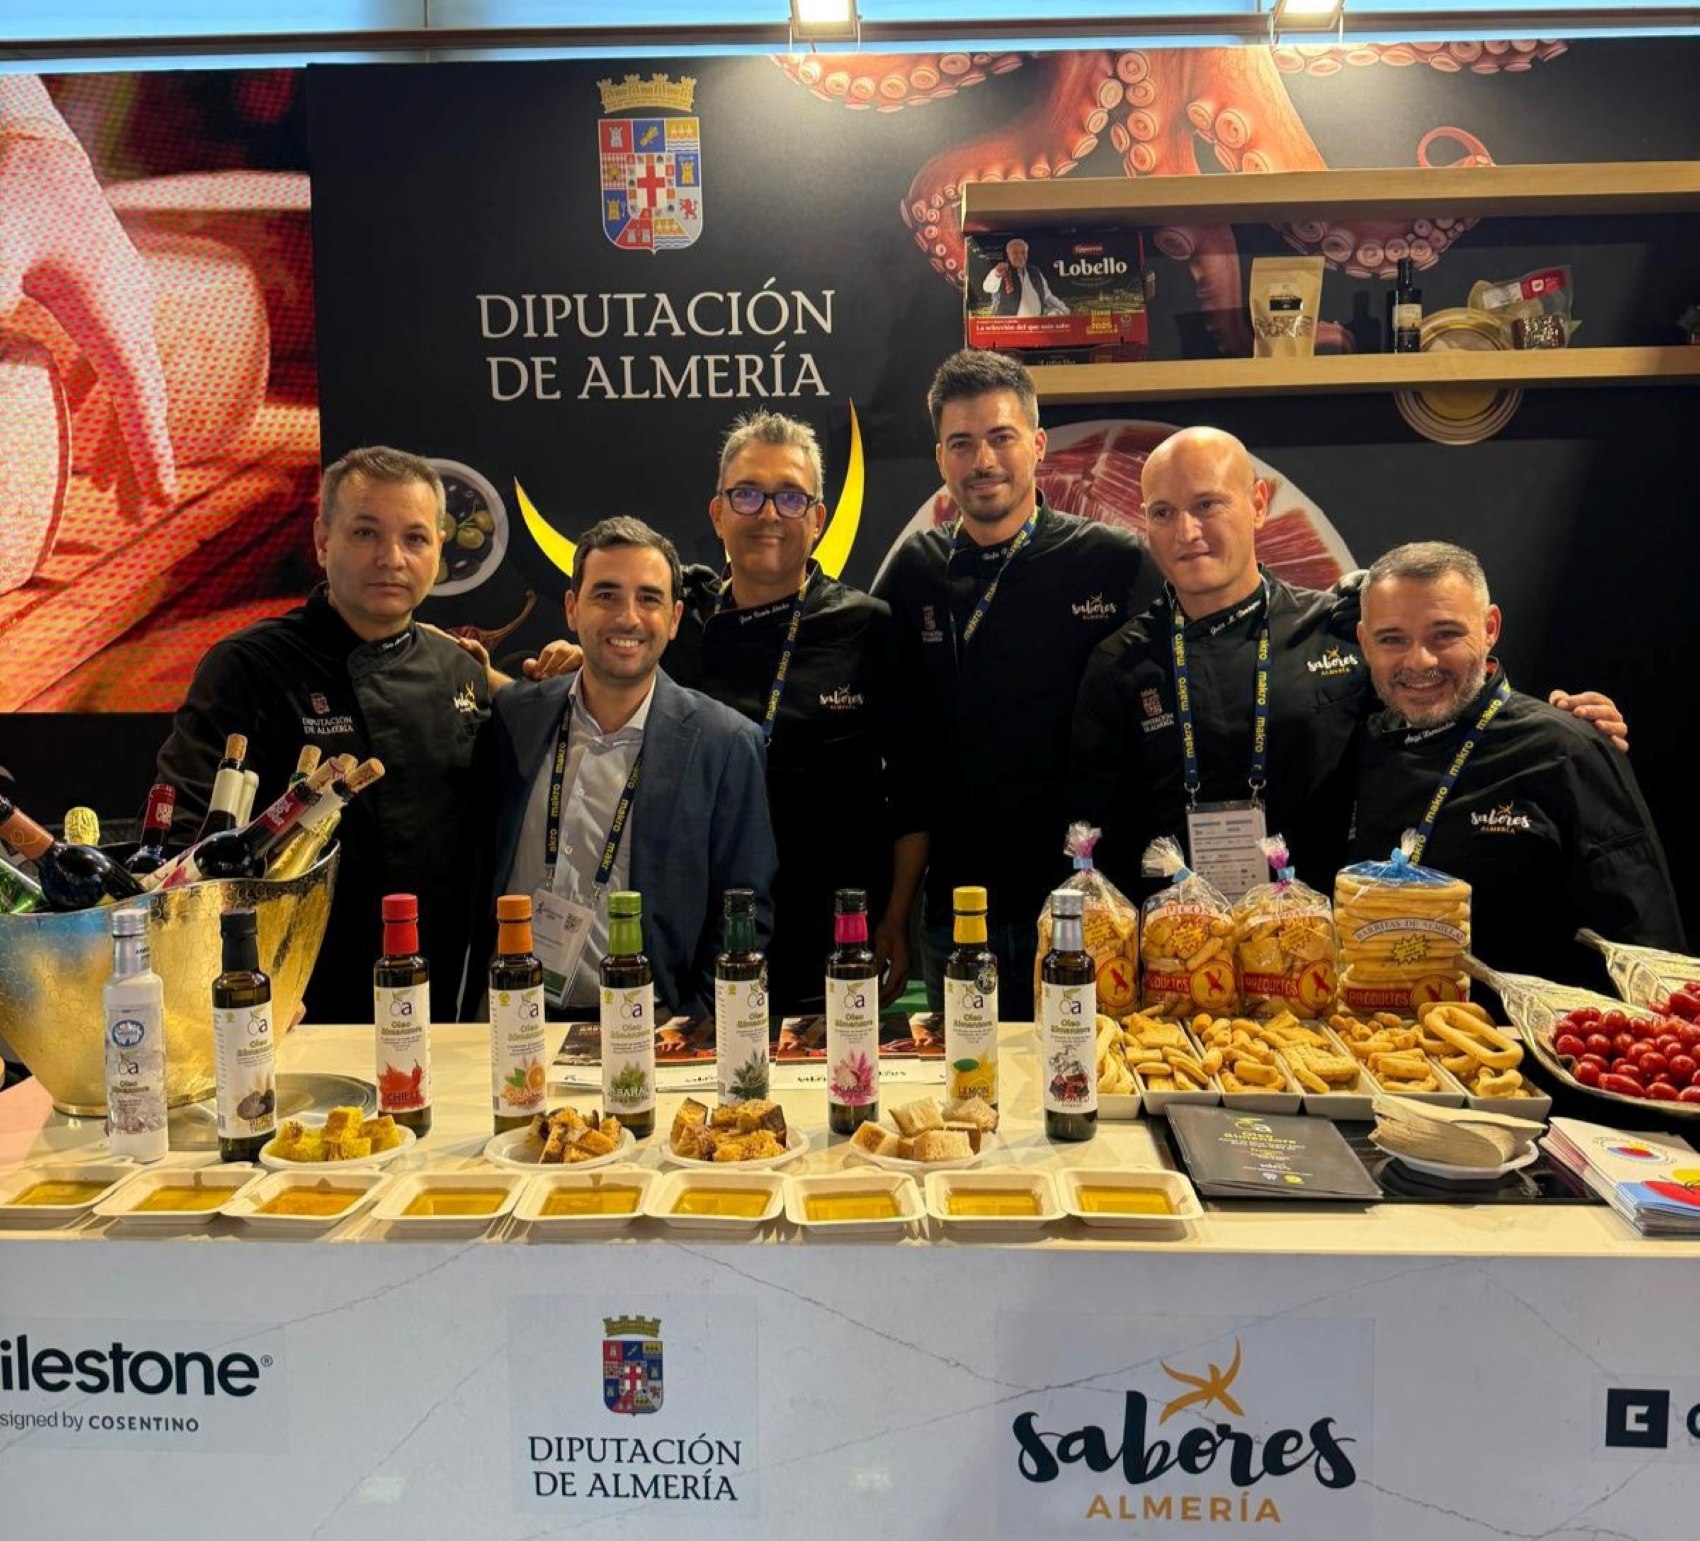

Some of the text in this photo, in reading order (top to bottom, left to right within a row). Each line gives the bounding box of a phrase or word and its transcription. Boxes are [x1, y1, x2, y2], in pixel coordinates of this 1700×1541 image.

[1054, 257, 1128, 277] Lobello
[476, 277, 836, 338] DIPUTACIÓN
[486, 341, 831, 401] DE ALMERÍA
[787, 611, 801, 642] makro
[963, 609, 984, 641] makro
[776, 651, 791, 681] makro
[1174, 633, 1185, 667] makro
[1306, 654, 1359, 673] sabores
[1178, 677, 1189, 712] makro
[1257, 671, 1267, 706] makro
[765, 690, 780, 721] makro
[1476, 699, 1503, 731] makro
[1183, 722, 1195, 758] makro
[1254, 716, 1266, 753] makro
[555, 742, 567, 774] makro
[1449, 740, 1474, 777] makro
[551, 784, 561, 818] makro
[612, 799, 629, 832] makro
[1425, 786, 1449, 824] makro
[1470, 808, 1532, 828] sabores
[549, 828, 558, 852] akro
[601, 842, 616, 870] makr
[1411, 834, 1427, 866] akro
[1355, 919, 1403, 941] BARRITAS
[1404, 919, 1418, 928] DE
[1347, 989, 1409, 1008] PRODUCTOS
[62, 1411, 84, 1432] by
[88, 1415, 200, 1433] COSENTINO
[528, 1433, 742, 1466] DIPUTACIÓN
[1012, 1390, 1357, 1489] sabores
[533, 1468, 739, 1501] DE ALMERÍA
[1086, 1491, 1282, 1523] ALMERÍA
